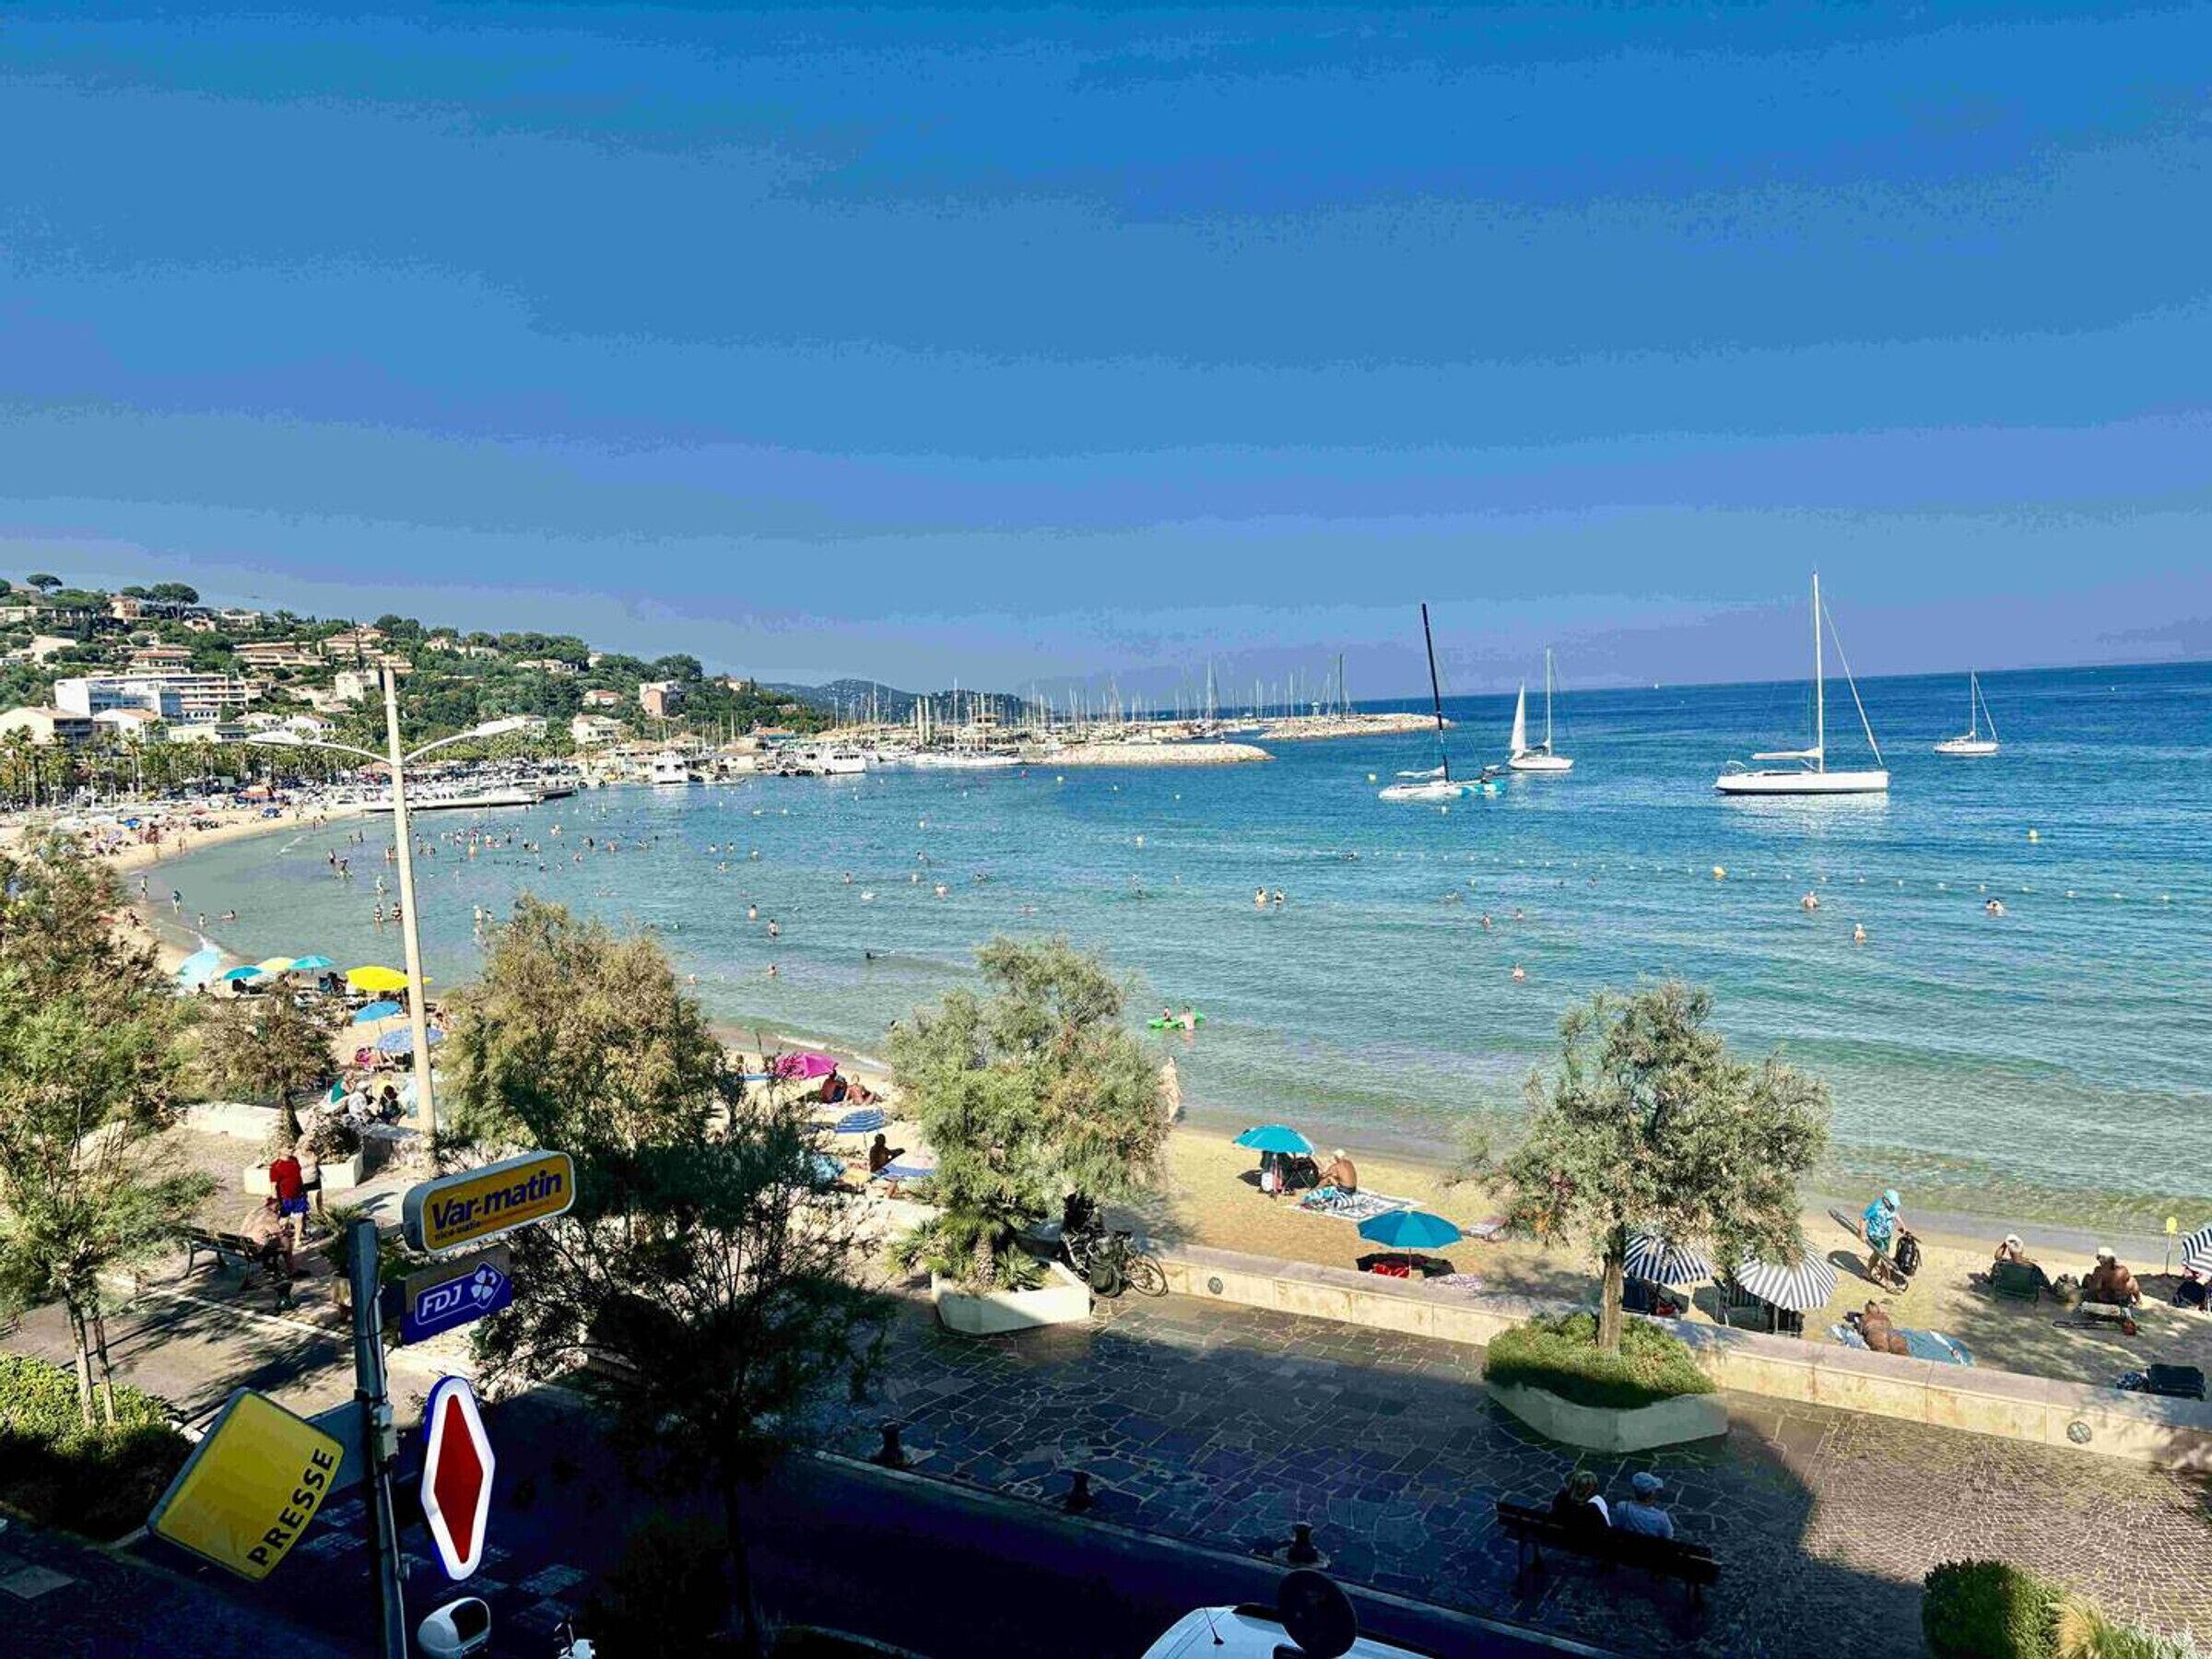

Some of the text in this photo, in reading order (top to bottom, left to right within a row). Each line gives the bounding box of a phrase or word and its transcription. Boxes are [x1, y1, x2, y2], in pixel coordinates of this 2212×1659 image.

[432, 1170, 561, 1230] Var-matin
[421, 1284, 462, 1317] FDJ
[246, 1448, 334, 1566] PRESSE
